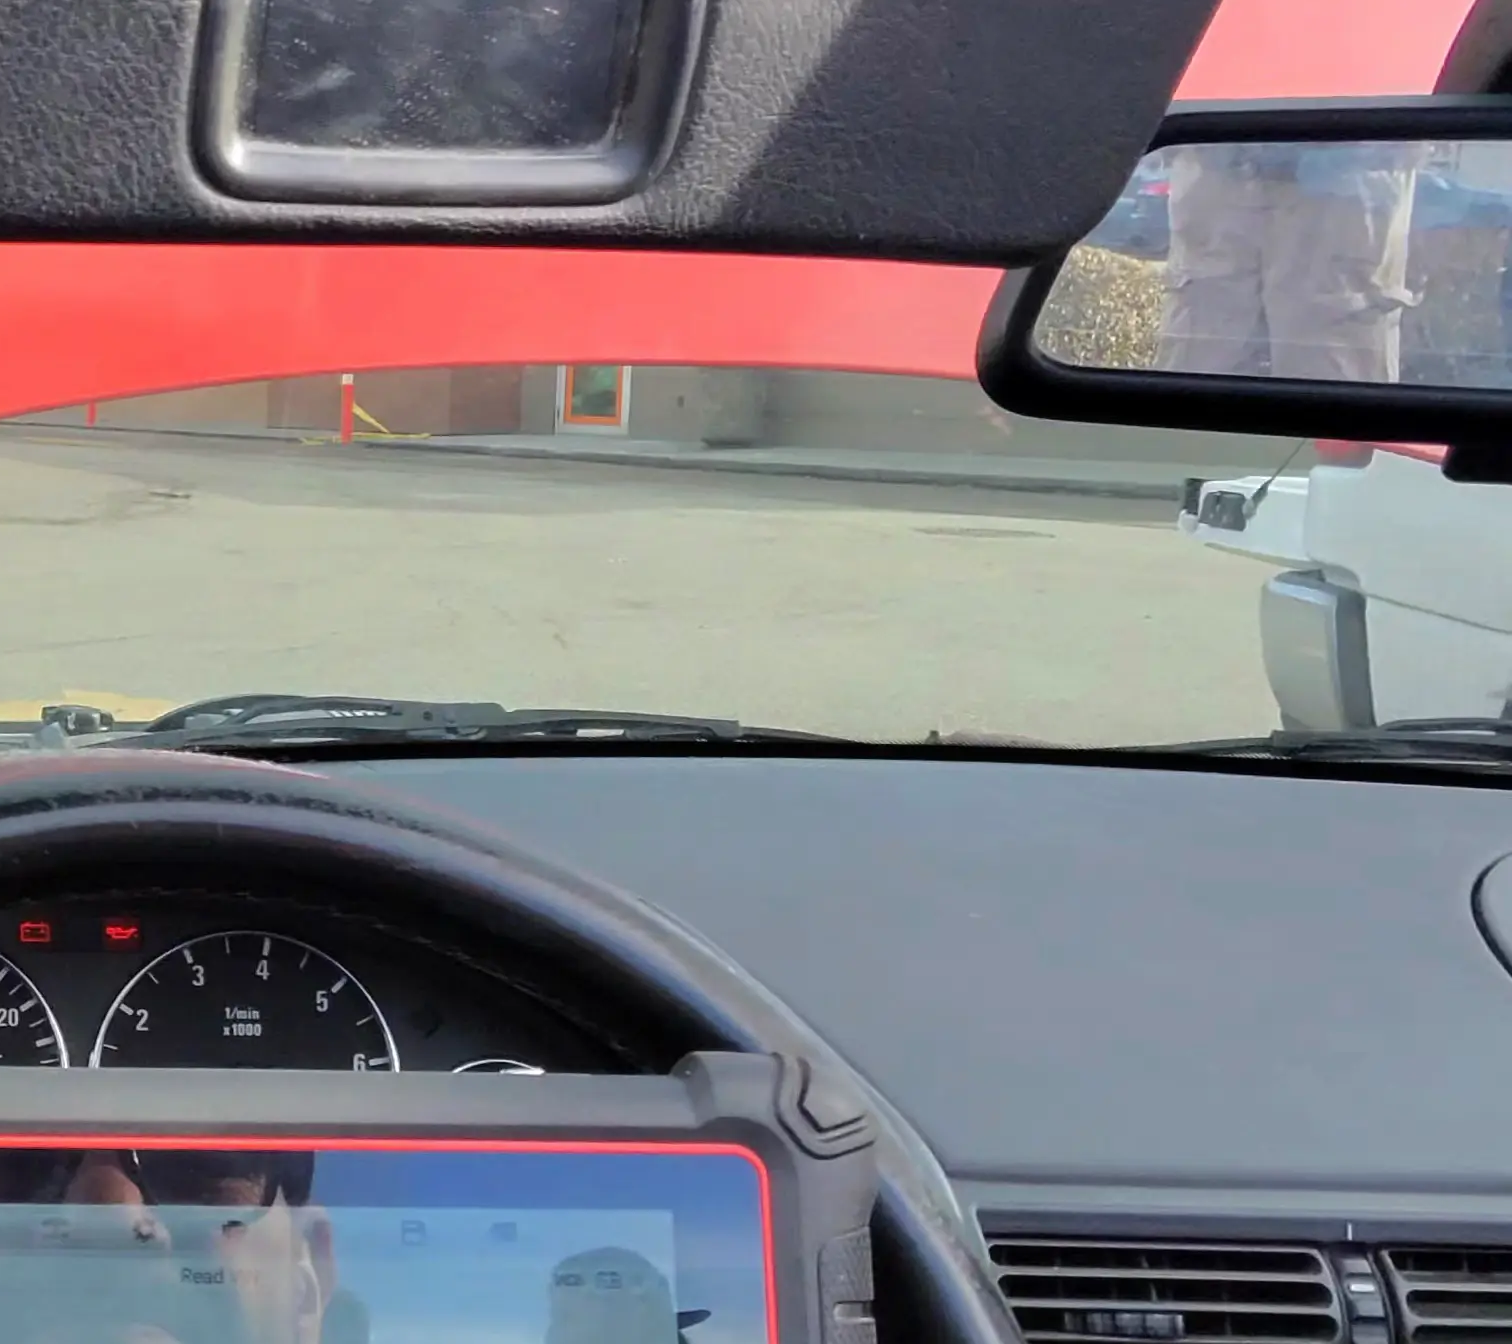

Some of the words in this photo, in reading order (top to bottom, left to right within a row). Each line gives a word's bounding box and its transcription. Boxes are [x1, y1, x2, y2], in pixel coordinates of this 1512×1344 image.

[192, 965, 205, 986] 3
[256, 959, 270, 980] 4
[316, 990, 329, 1012] 5
[135, 1009, 149, 1031] 2
[353, 1054, 367, 1071] 6
